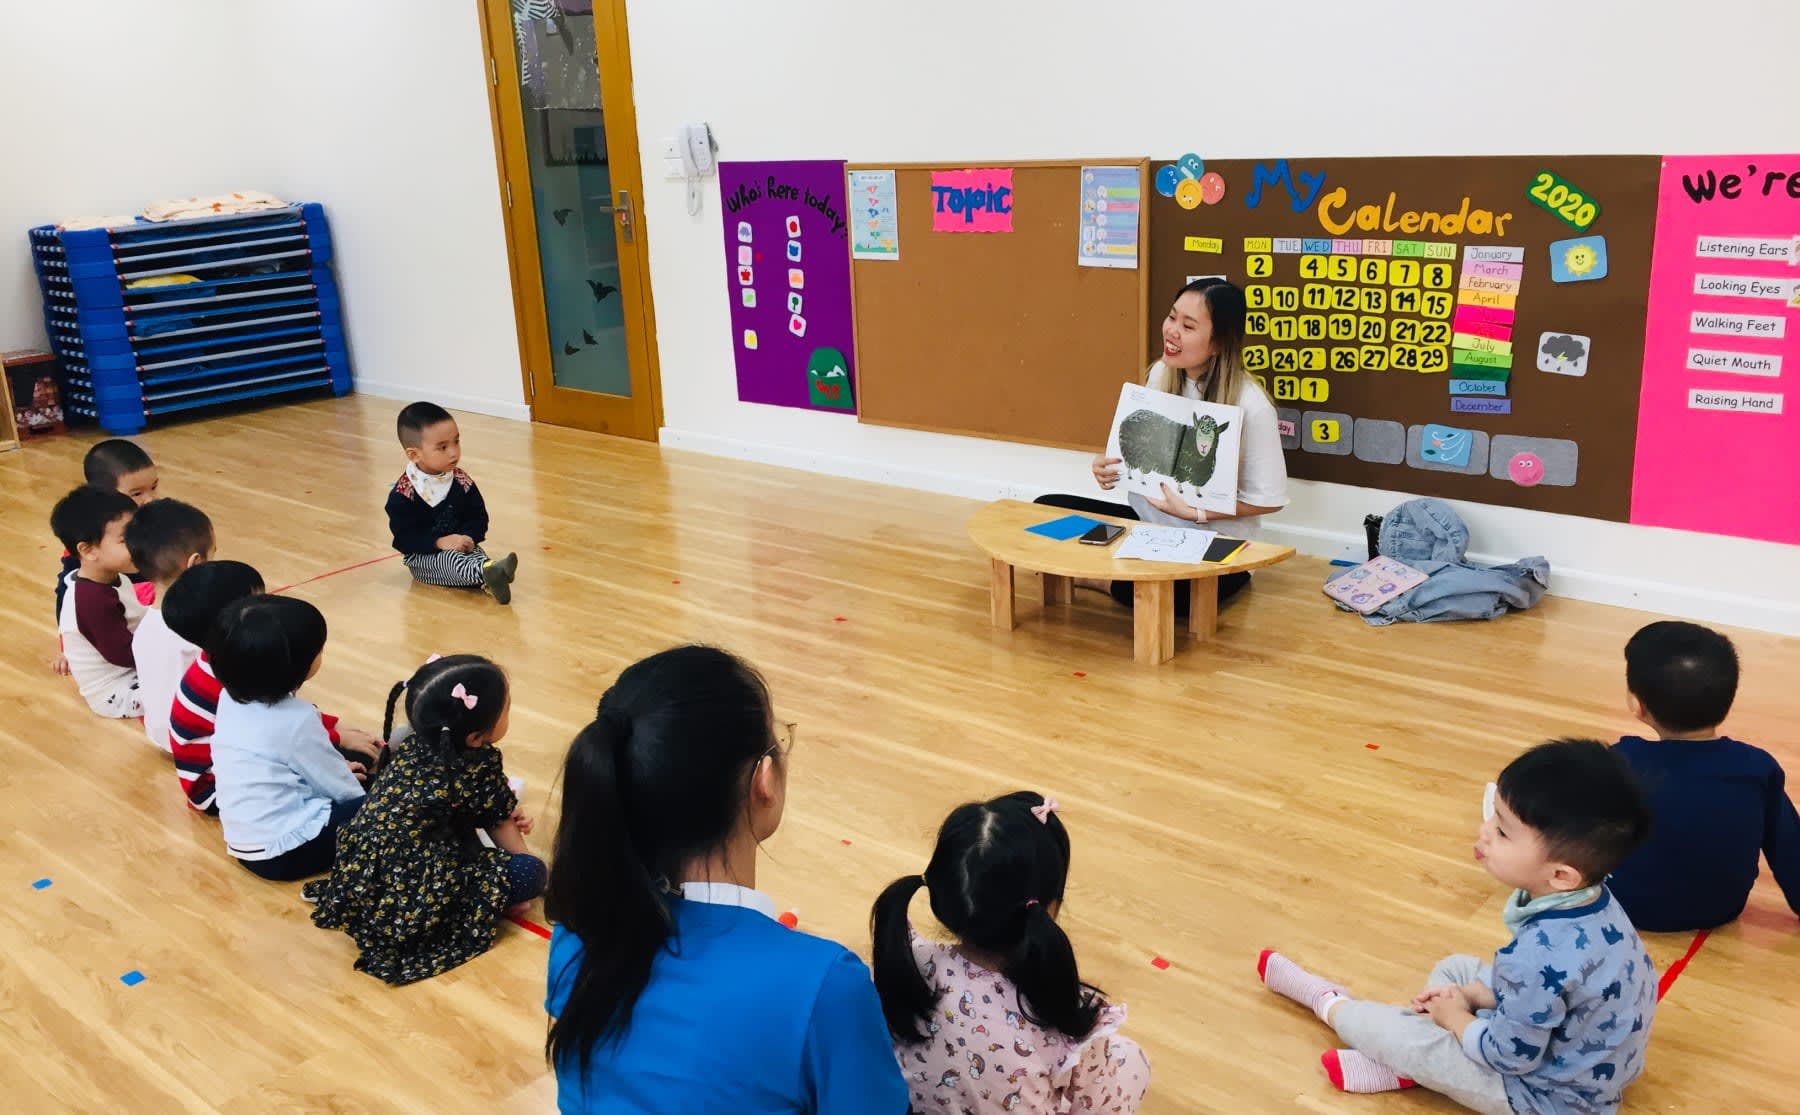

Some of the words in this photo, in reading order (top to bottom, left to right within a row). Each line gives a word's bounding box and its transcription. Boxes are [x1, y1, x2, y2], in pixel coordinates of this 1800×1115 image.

[767, 175, 799, 201] here
[1682, 164, 1800, 204] We're
[930, 182, 1012, 223] Topic
[1243, 158, 1327, 213] My
[1317, 186, 1512, 237] Calendar
[1530, 173, 1596, 227] 2020
[1192, 239, 1220, 252] Monday
[1247, 240, 1267, 250] MON
[1279, 240, 1299, 251] TUE
[1304, 241, 1330, 252] WED
[1336, 241, 1359, 252] THU
[1368, 241, 1387, 253] FRI
[1396, 243, 1417, 254] SAT
[1428, 246, 1451, 258] SUN
[1471, 247, 1513, 260] January
[1699, 241, 1755, 257] Listening
[1759, 243, 1788, 256] Ears
[1254, 257, 1265, 275] 2
[1306, 258, 1318, 277] 4
[1337, 258, 1347, 277] 5
[1366, 262, 1378, 280] 6
[1400, 264, 1410, 283] 7
[1432, 267, 1443, 286] 8
[1474, 263, 1509, 275] March
[1468, 276, 1512, 292] February
[1700, 279, 1747, 294] Looking
[1750, 281, 1781, 295] Eyes
[1252, 287, 1264, 306] 9
[1275, 290, 1295, 308] 10
[1308, 288, 1325, 305] 11
[1335, 288, 1356, 307] 12
[1364, 291, 1382, 309] 13
[1395, 291, 1416, 310] 14
[1427, 295, 1447, 315] 15
[1472, 292, 1500, 305] April
[1247, 315, 1265, 332] 16
[1274, 320, 1292, 338] 17
[1303, 319, 1320, 337] 18
[1331, 318, 1352, 336] 19
[1362, 320, 1381, 339] 20
[1396, 322, 1416, 341] 21
[1422, 324, 1447, 343] 22
[1695, 317, 1743, 332] Walking
[1746, 319, 1776, 331] Feet
[1472, 337, 1495, 352] July
[1244, 349, 1265, 367] 23
[1275, 352, 1295, 369] 24
[1335, 350, 1355, 369] 26
[1363, 349, 1385, 368] 27
[1395, 347, 1417, 367] 28
[1420, 348, 1443, 369] 29
[1464, 352, 1497, 364] August
[1692, 353, 1727, 366] Quiet
[1731, 357, 1771, 370] Mouth
[1277, 379, 1295, 398] 31
[1309, 381, 1317, 398] 1
[1458, 381, 1496, 392] October
[1455, 400, 1503, 411] December
[1695, 394, 1738, 408] Raising
[1742, 396, 1774, 409] Hand
[1319, 422, 1330, 440] 3
